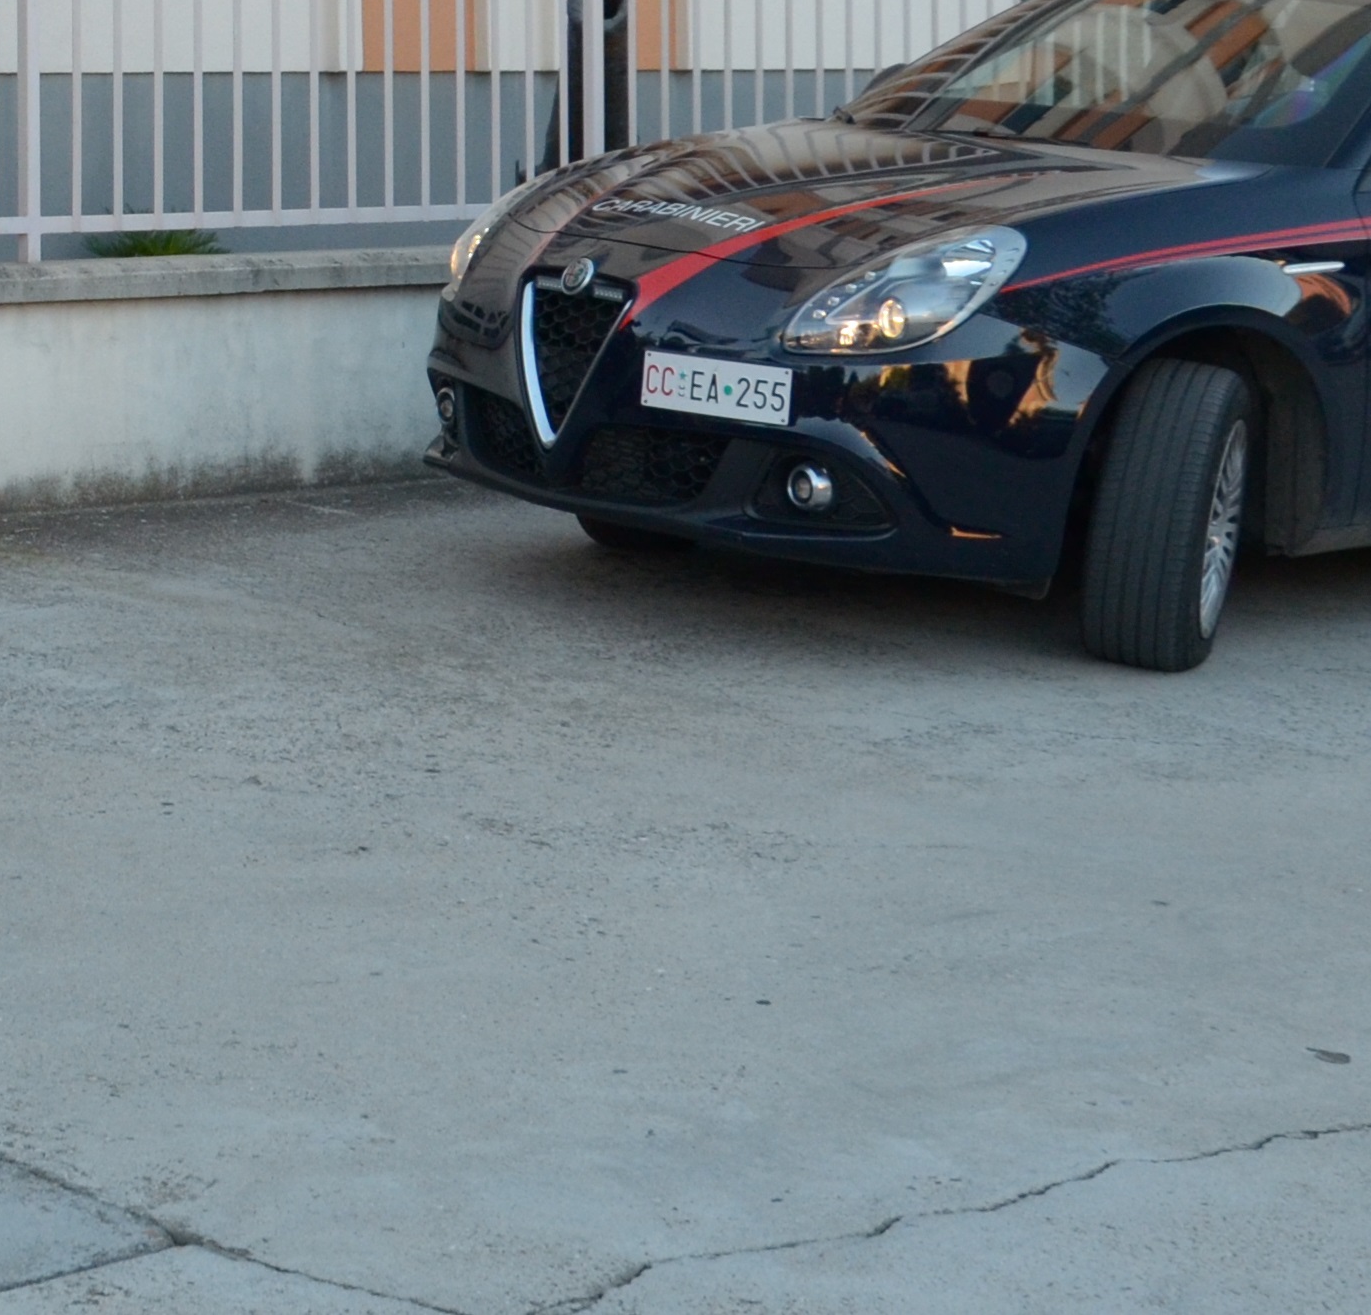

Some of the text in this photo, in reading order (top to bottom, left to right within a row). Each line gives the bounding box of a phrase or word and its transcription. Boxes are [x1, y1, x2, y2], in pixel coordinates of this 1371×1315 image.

[591, 199, 766, 233] CARABINIERI
[646, 364, 786, 412] CC EA 255
